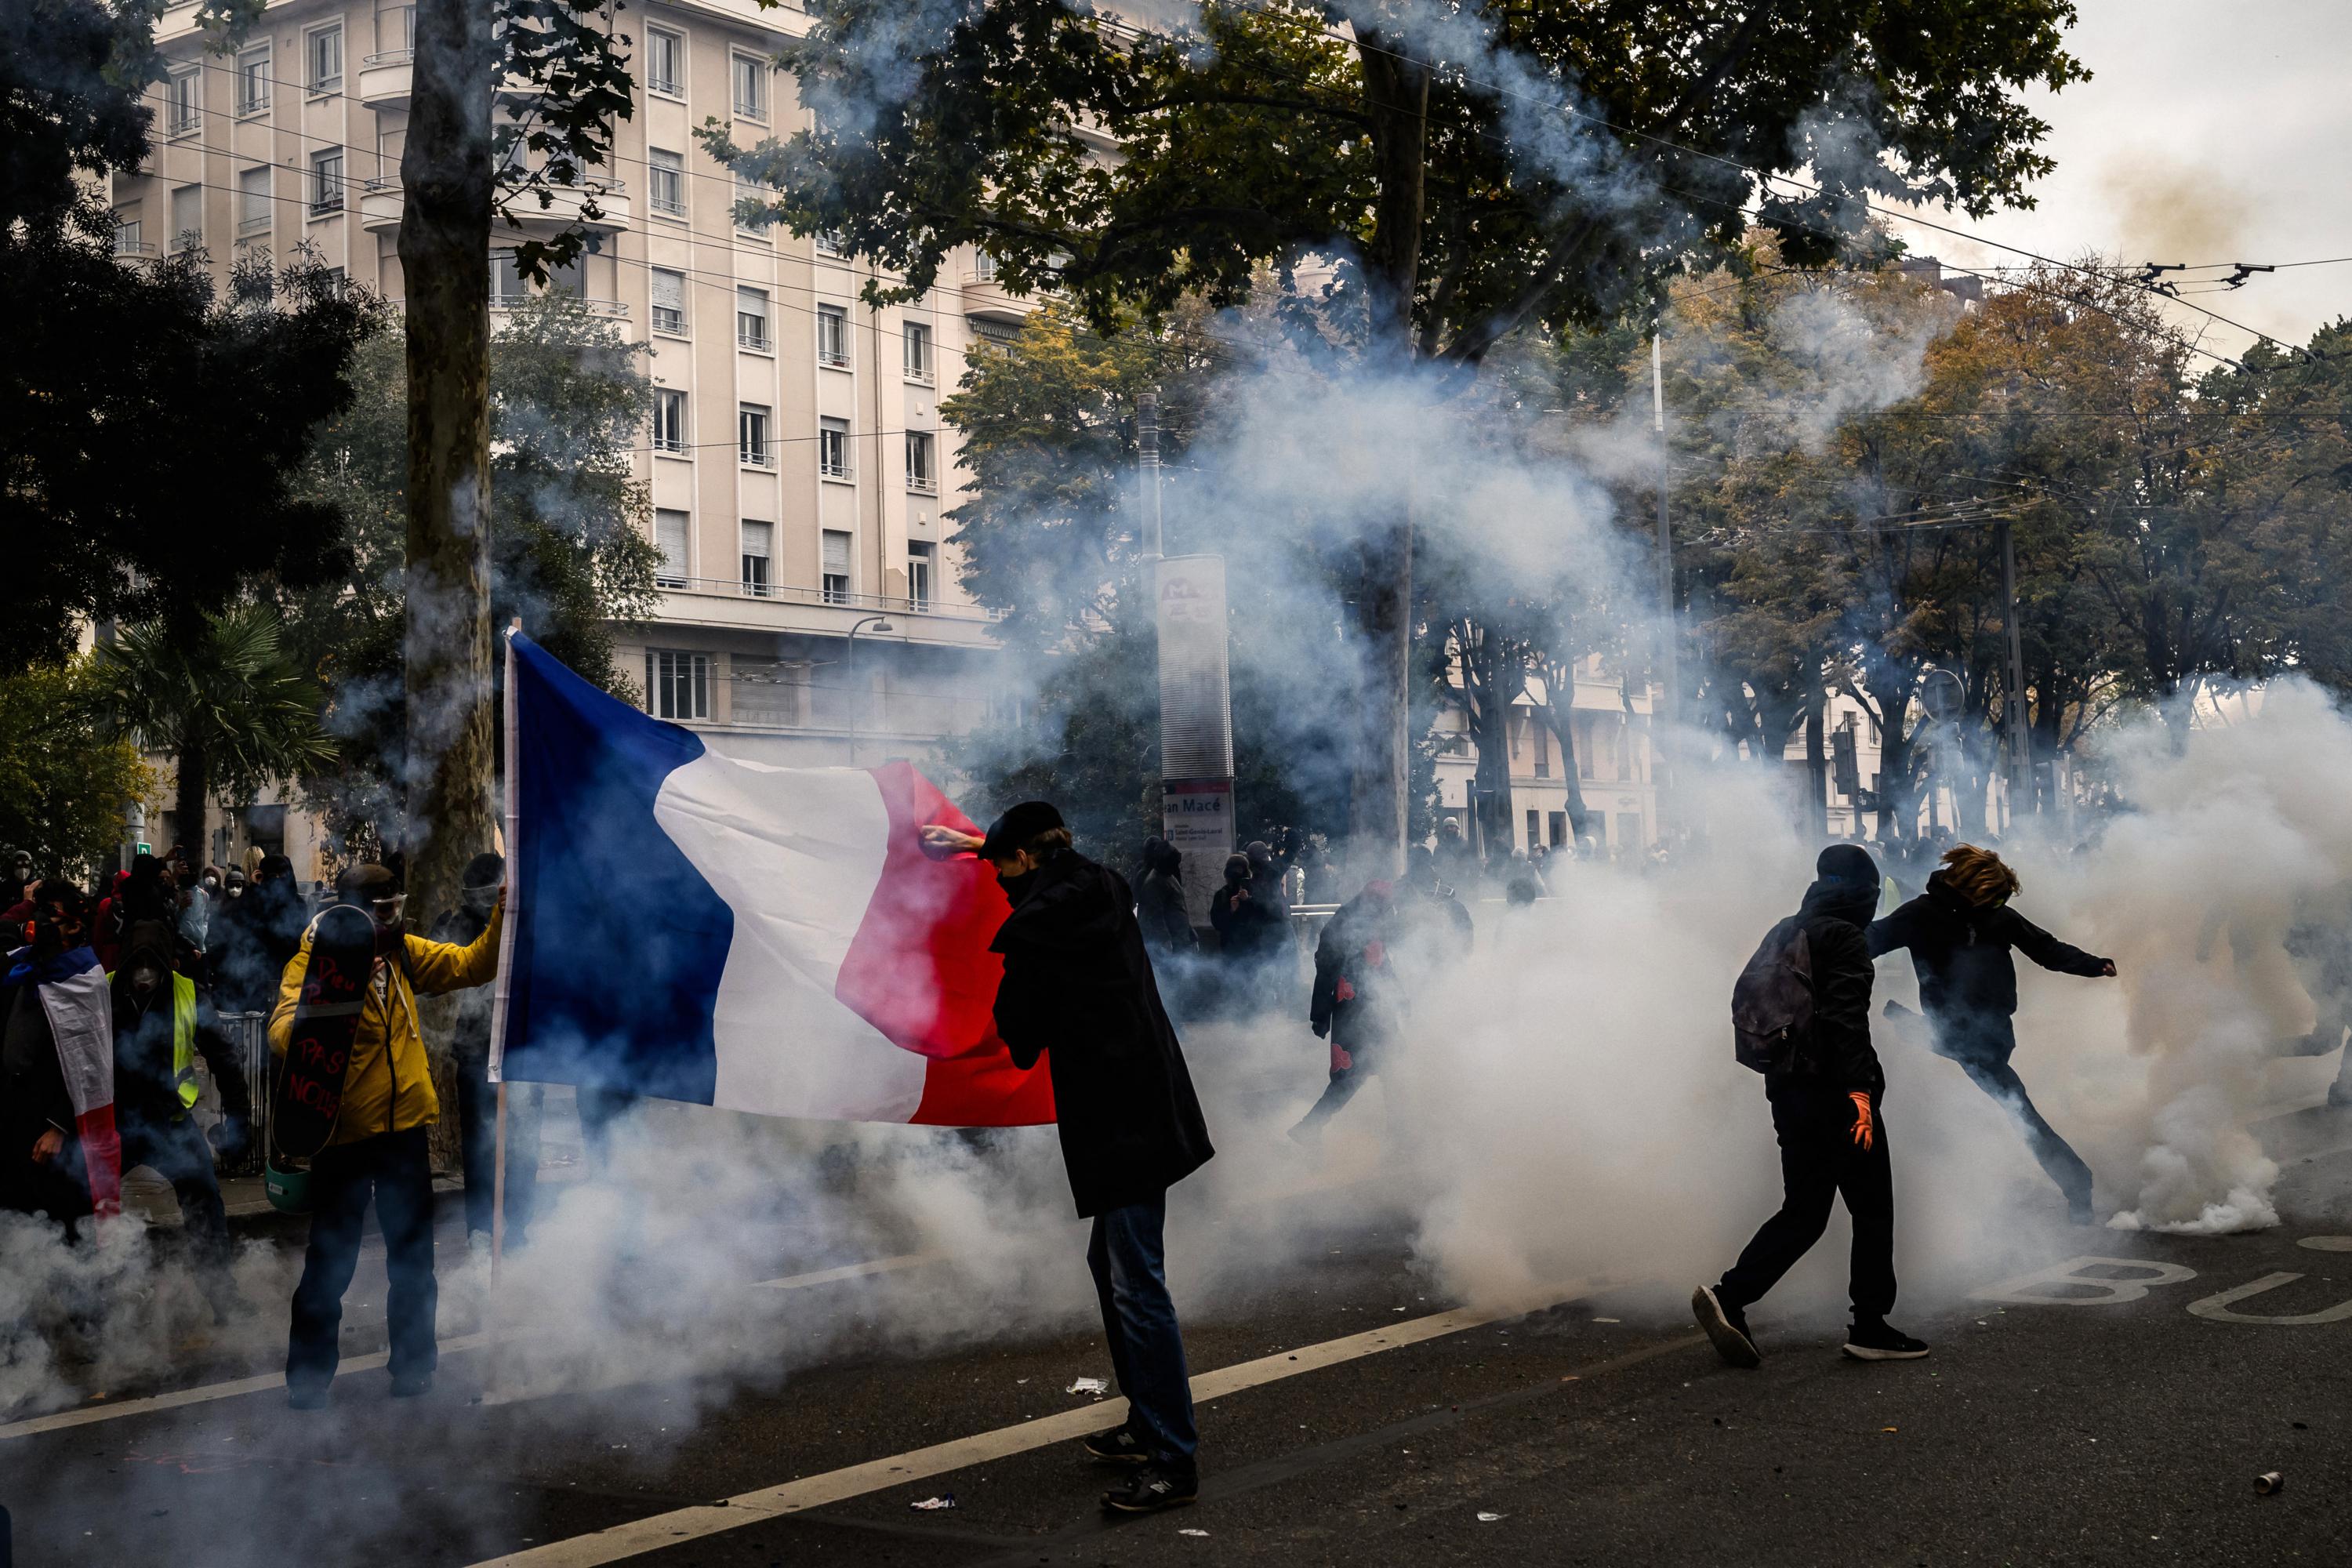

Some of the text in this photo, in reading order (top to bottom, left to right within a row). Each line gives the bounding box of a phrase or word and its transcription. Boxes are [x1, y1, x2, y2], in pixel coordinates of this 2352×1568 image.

[1182, 797, 1220, 812] Macé
[297, 1037, 345, 1074] PAS
[289, 1073, 339, 1119] NOUS
